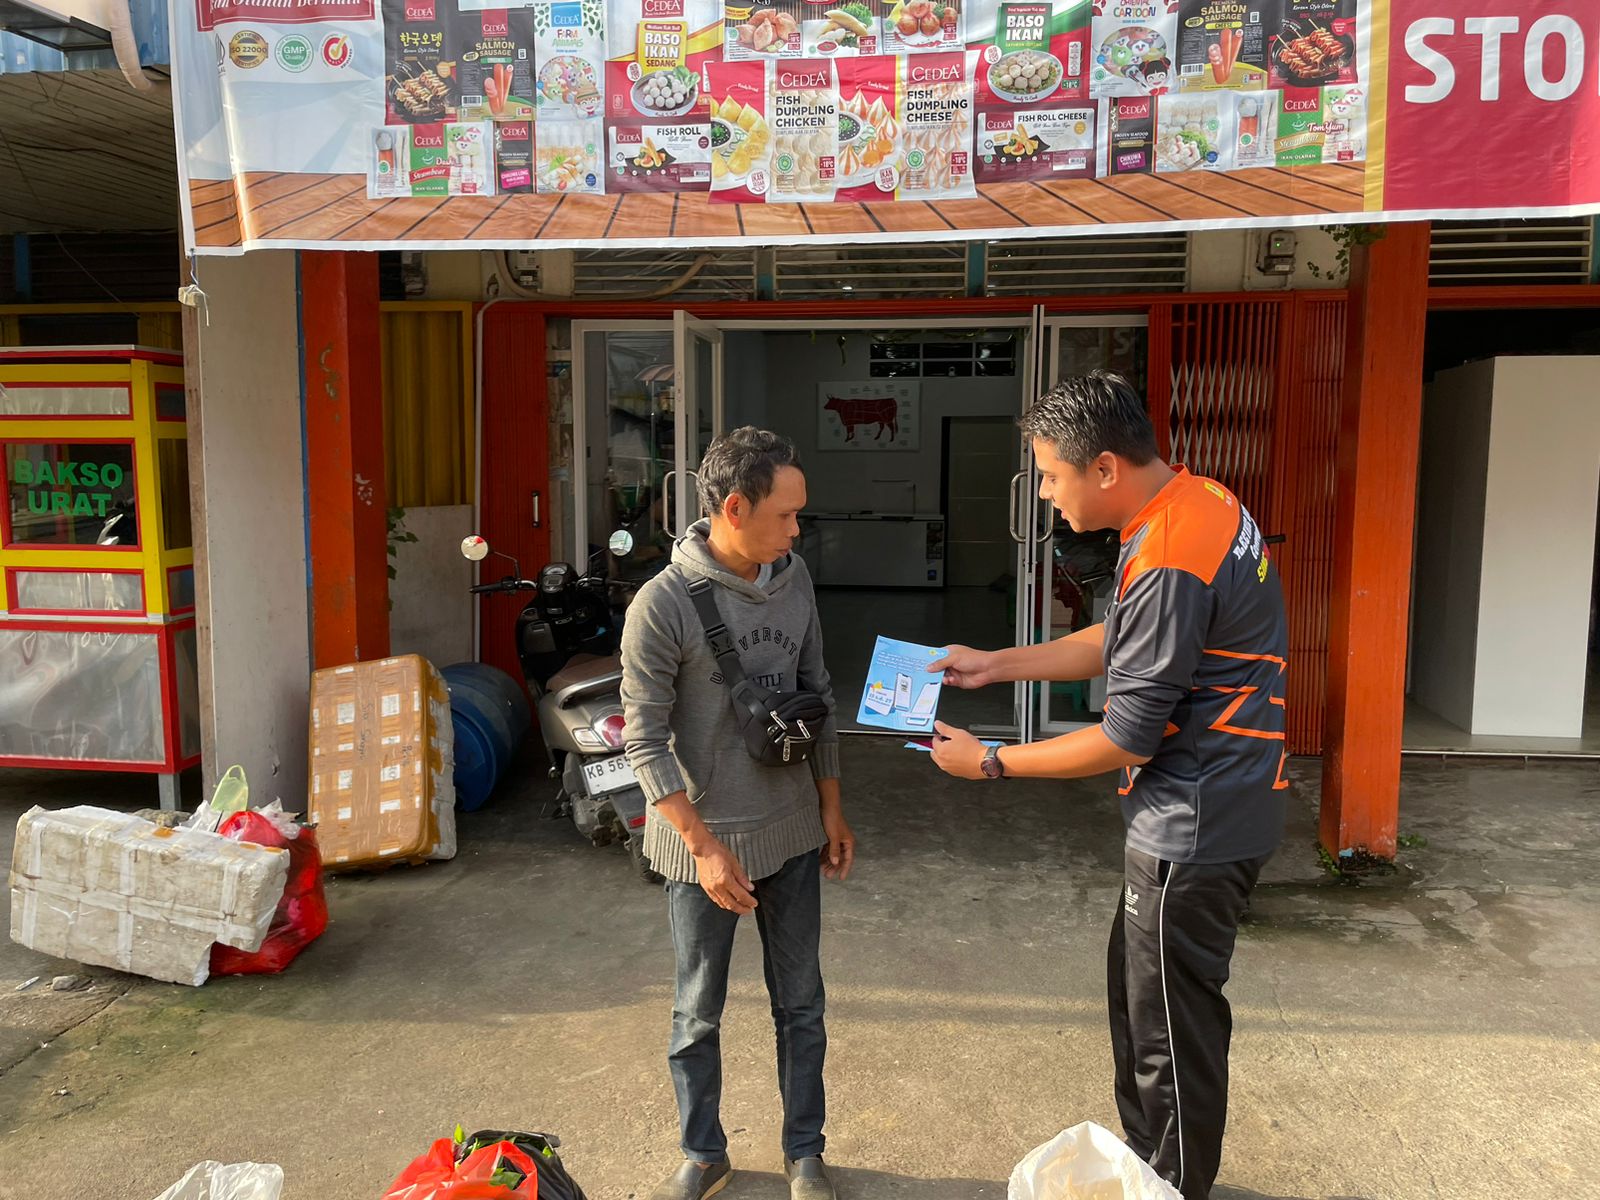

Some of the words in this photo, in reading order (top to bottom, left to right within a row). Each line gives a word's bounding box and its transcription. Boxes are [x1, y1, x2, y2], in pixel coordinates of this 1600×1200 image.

[1113, 6, 1157, 18] CARTOON
[1200, 4, 1248, 16] SALMON
[1006, 15, 1045, 28] BASO
[1204, 13, 1243, 22] SAUSAGE
[645, 32, 681, 46] BASO
[1005, 28, 1044, 41] IKAN
[283, 46, 306, 54] GMP
[475, 41, 515, 51] SALMON
[479, 49, 512, 57] SAUSAGE
[645, 46, 680, 59] IKAN
[1404, 13, 1600, 104] STO
[646, 59, 677, 67] SEDANG
[911, 64, 960, 81] CEDEA
[780, 71, 826, 87] CEDEA
[775, 95, 801, 105] FISH
[907, 89, 934, 100] FISH
[775, 105, 835, 117] DUMPLING
[907, 98, 968, 112] DUMPLING
[1119, 104, 1147, 115] CEDEA
[1284, 99, 1317, 111] CEDEA
[775, 117, 826, 128] CHICKEN
[906, 111, 953, 123] CHEESE
[1018, 115, 1035, 123] FISH
[1037, 113, 1056, 122] ROLL
[1057, 112, 1088, 121] CHEESE
[986, 119, 1013, 130] CEDEA
[656, 127, 677, 136] FISH
[679, 126, 701, 136] ROLL
[414, 136, 442, 146] CEDEA
[15, 459, 123, 488] BAKSO
[28, 490, 112, 517] URAT
[586, 764, 604, 779] KB
